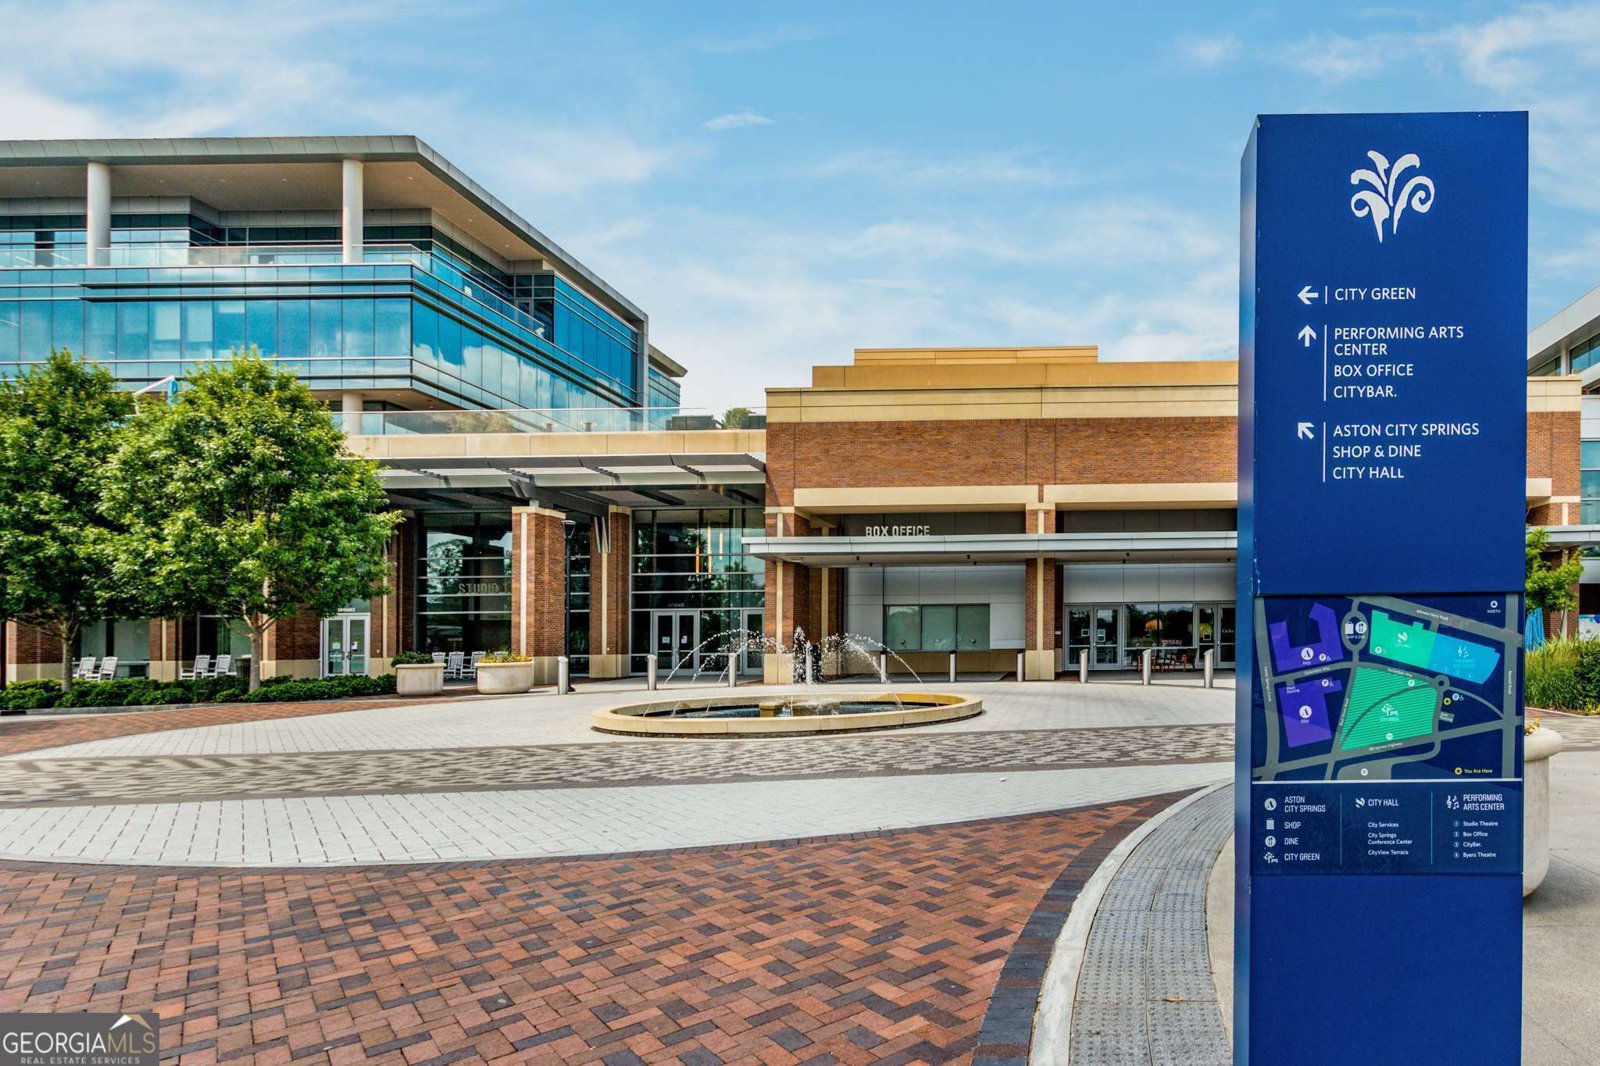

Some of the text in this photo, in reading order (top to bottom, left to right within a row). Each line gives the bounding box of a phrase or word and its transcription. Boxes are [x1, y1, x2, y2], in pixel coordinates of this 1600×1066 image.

[1334, 287, 1416, 301] CITY GREEN
[1334, 326, 1464, 340] PERFORMING ARTS
[1334, 343, 1388, 356] CENTER
[1334, 364, 1414, 377] BOX OFFICE
[1333, 386, 1397, 398] CITYBAR.
[1333, 423, 1480, 437] ASTON CITY SPRINGS
[1333, 445, 1422, 458] SHOP & DINE
[1333, 466, 1404, 480] CITY HALL
[865, 525, 930, 537] BOX OFFICE
[458, 583, 499, 594] STUDIO
[1284, 796, 1305, 804] ASTON
[1368, 798, 1399, 807] CITY HALL
[1463, 794, 1503, 802] PERFORMING
[1284, 804, 1326, 813] CITY SPRINGS
[1463, 802, 1505, 811] ARTS CENTER
[1284, 821, 1301, 829] SHOP
[1284, 837, 1299, 845] DINE
[1284, 852, 1320, 861] CITY GREEN
